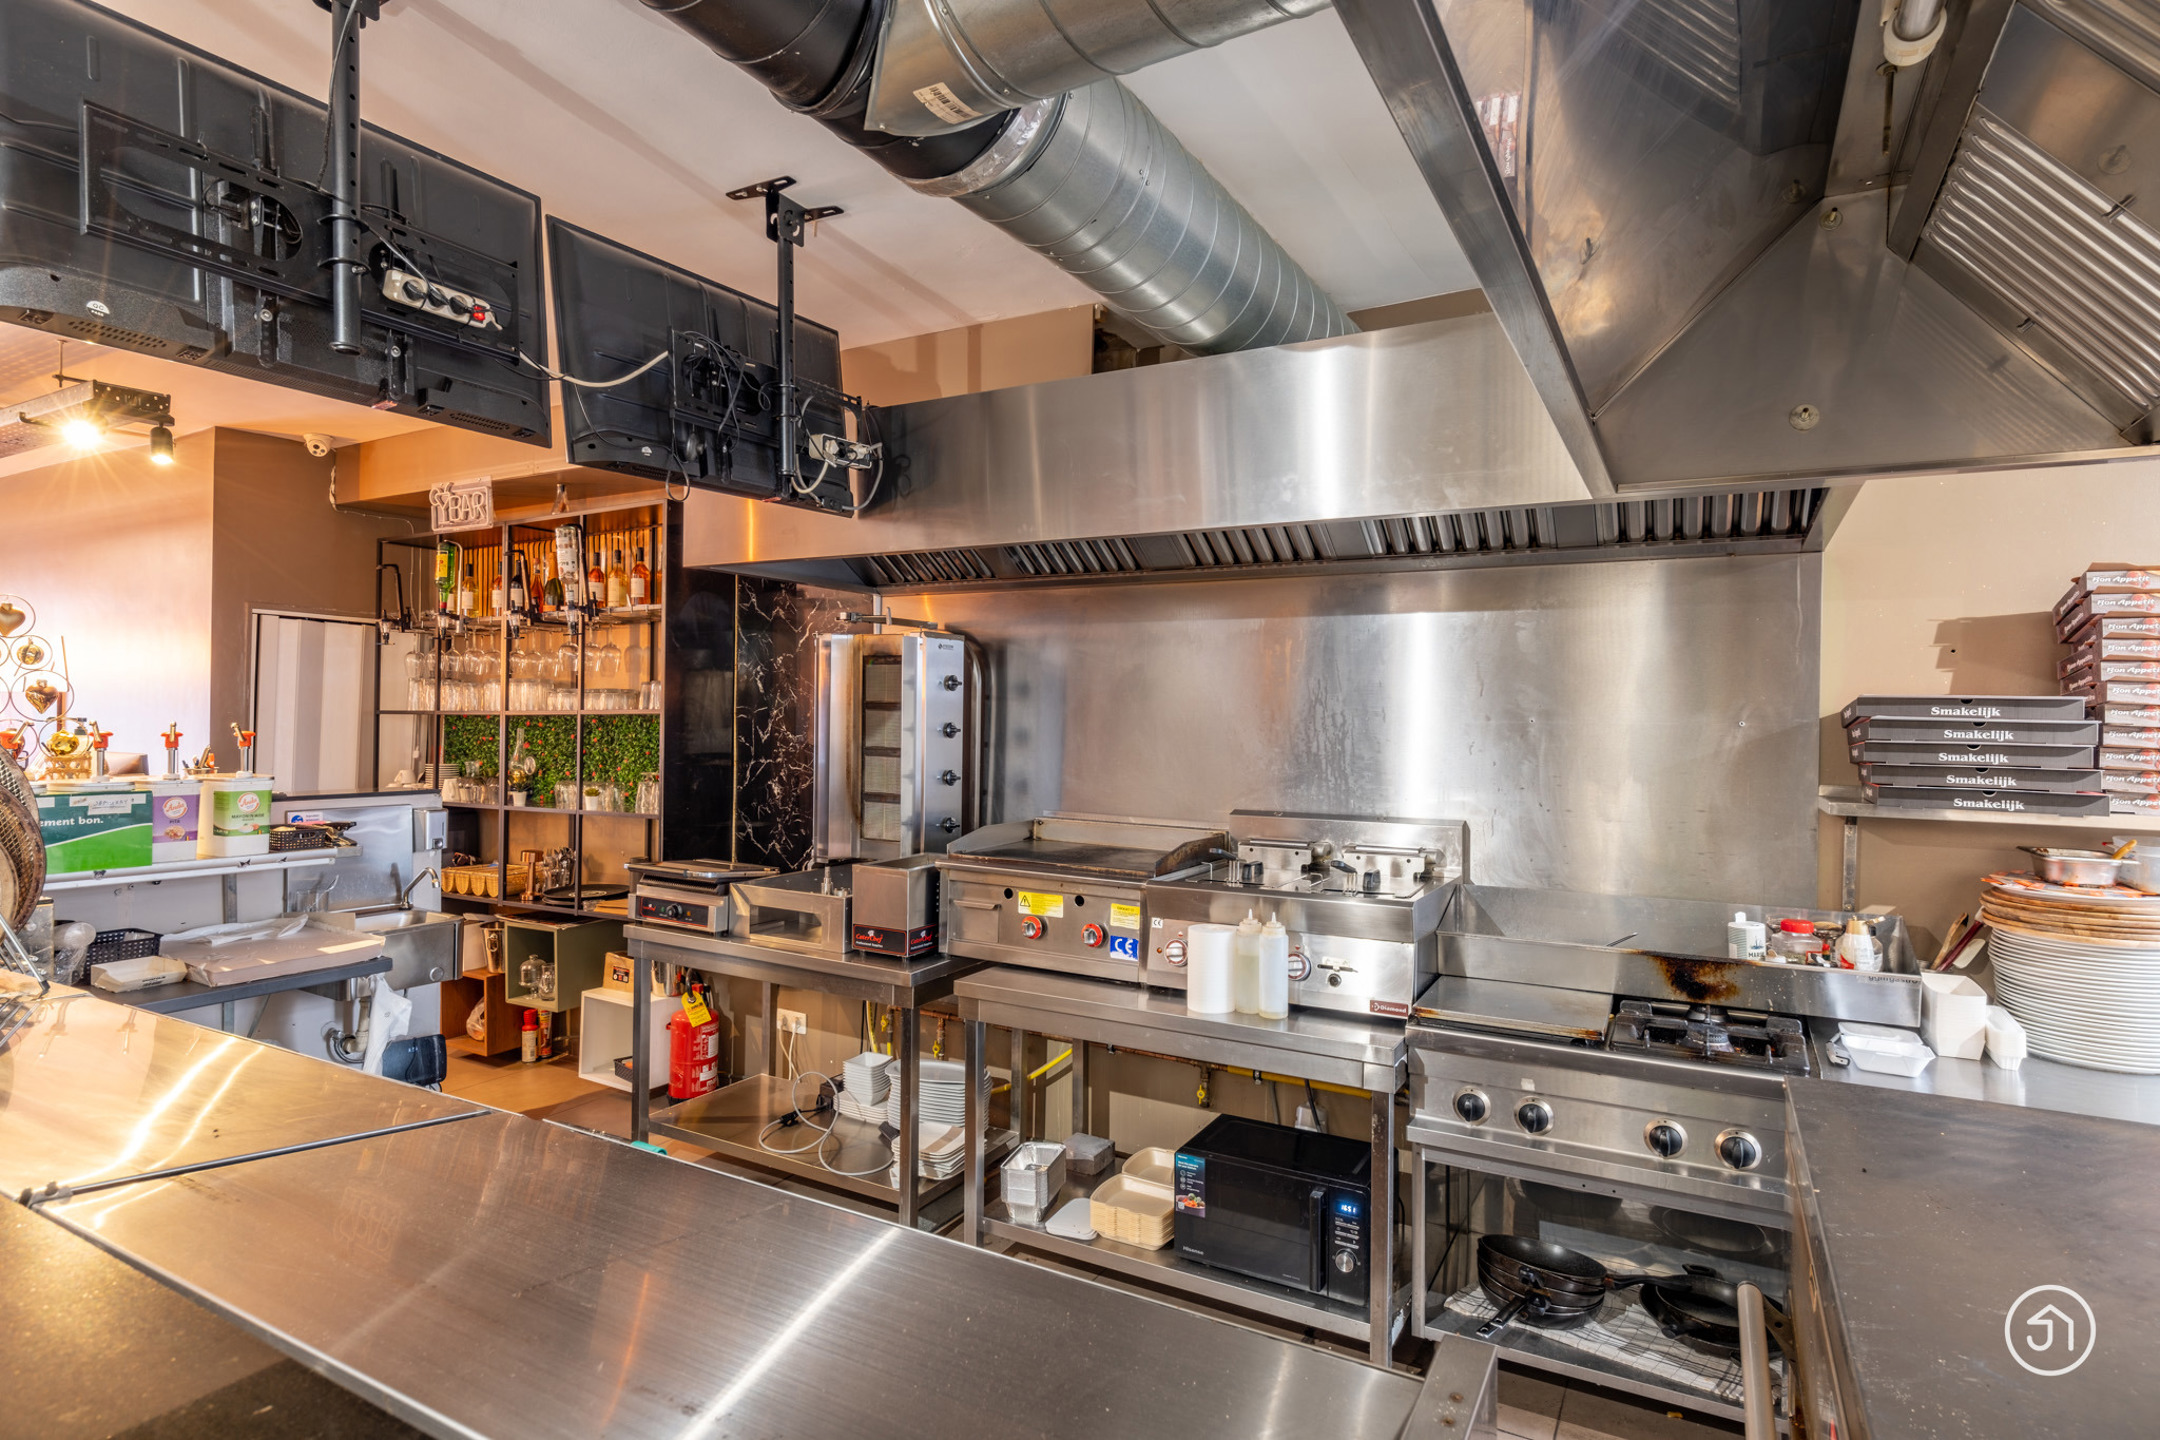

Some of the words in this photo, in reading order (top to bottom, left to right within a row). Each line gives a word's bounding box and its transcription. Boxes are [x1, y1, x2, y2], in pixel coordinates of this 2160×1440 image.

[2129, 623, 2160, 631] Appet
[2128, 644, 2160, 652] Appeti
[2132, 687, 2160, 695] Appet
[1931, 707, 2001, 718] Smakelijk
[2131, 709, 2160, 717] Appet
[1944, 729, 2014, 742] Smakelijk
[1938, 752, 2009, 765] Smakelijk
[2126, 752, 2160, 760] Appeti
[1946, 774, 2017, 788] Smakelijk
[2126, 775, 2160, 783] Appeti
[1953, 797, 2025, 811] Smakelijk
[2132, 798, 2160, 806] Appet
[40, 818, 75, 827] ement
[78, 816, 104, 825] bon.
[1380, 1004, 1407, 1013] Diamond
